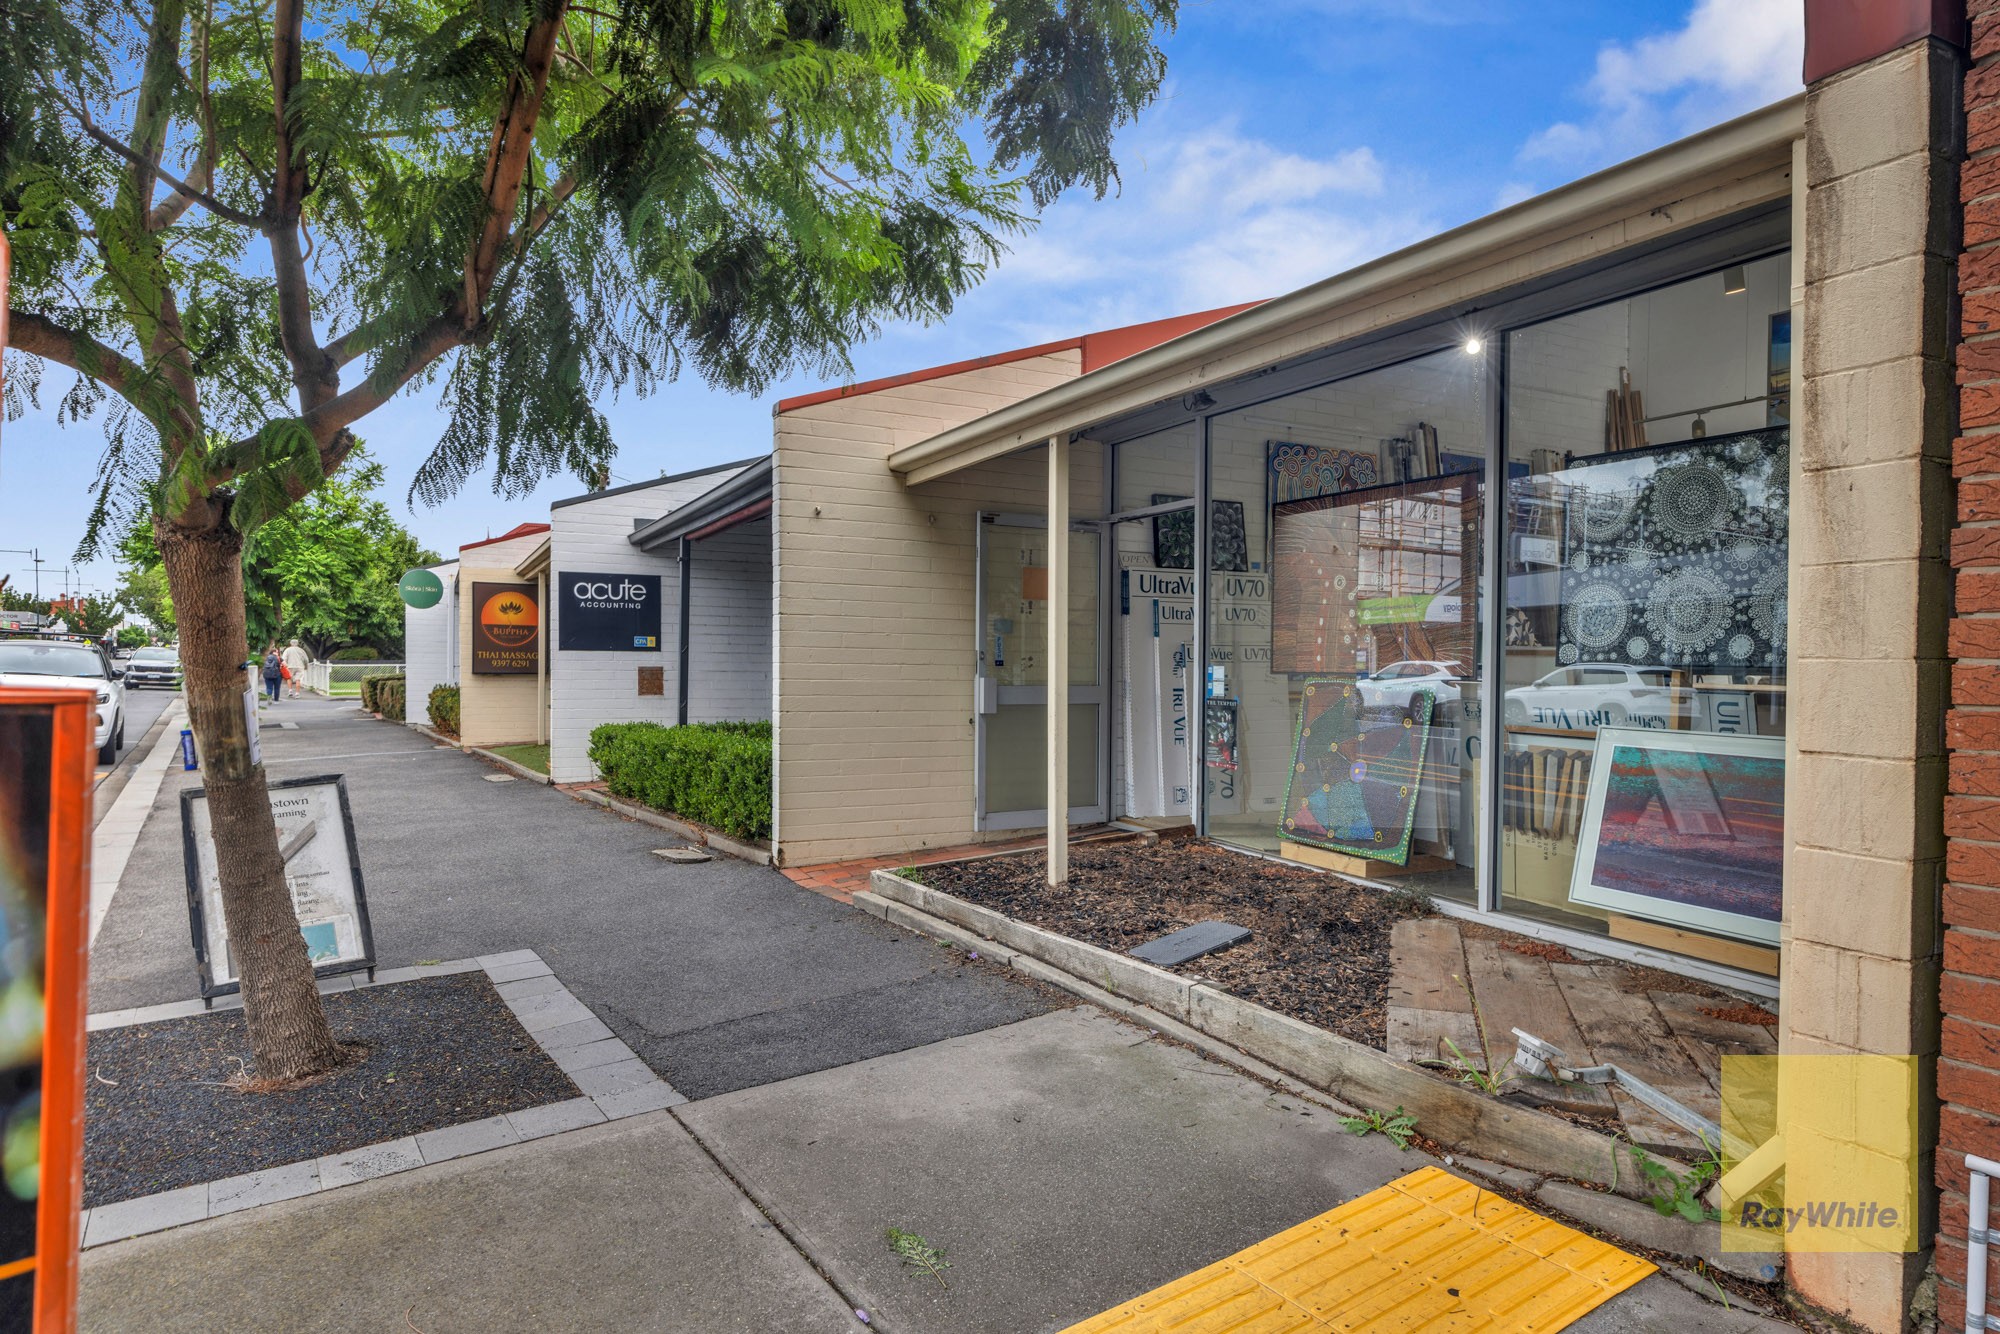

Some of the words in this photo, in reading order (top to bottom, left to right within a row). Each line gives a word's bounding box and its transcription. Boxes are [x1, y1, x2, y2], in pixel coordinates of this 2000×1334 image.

[1122, 555, 1149, 564] OPEN
[574, 579, 647, 601] acute
[1139, 574, 1194, 595] UltraV
[1226, 578, 1265, 597] UV70
[580, 601, 641, 610] ACCOUNTING
[1225, 608, 1256, 622] UV70
[493, 627, 529, 636] BUPPHA
[477, 651, 499, 659] THAI
[501, 651, 538, 660] MASSAG
[492, 660, 511, 668] 9397
[512, 660, 530, 668] 6291
[273, 810, 307, 819] raming
